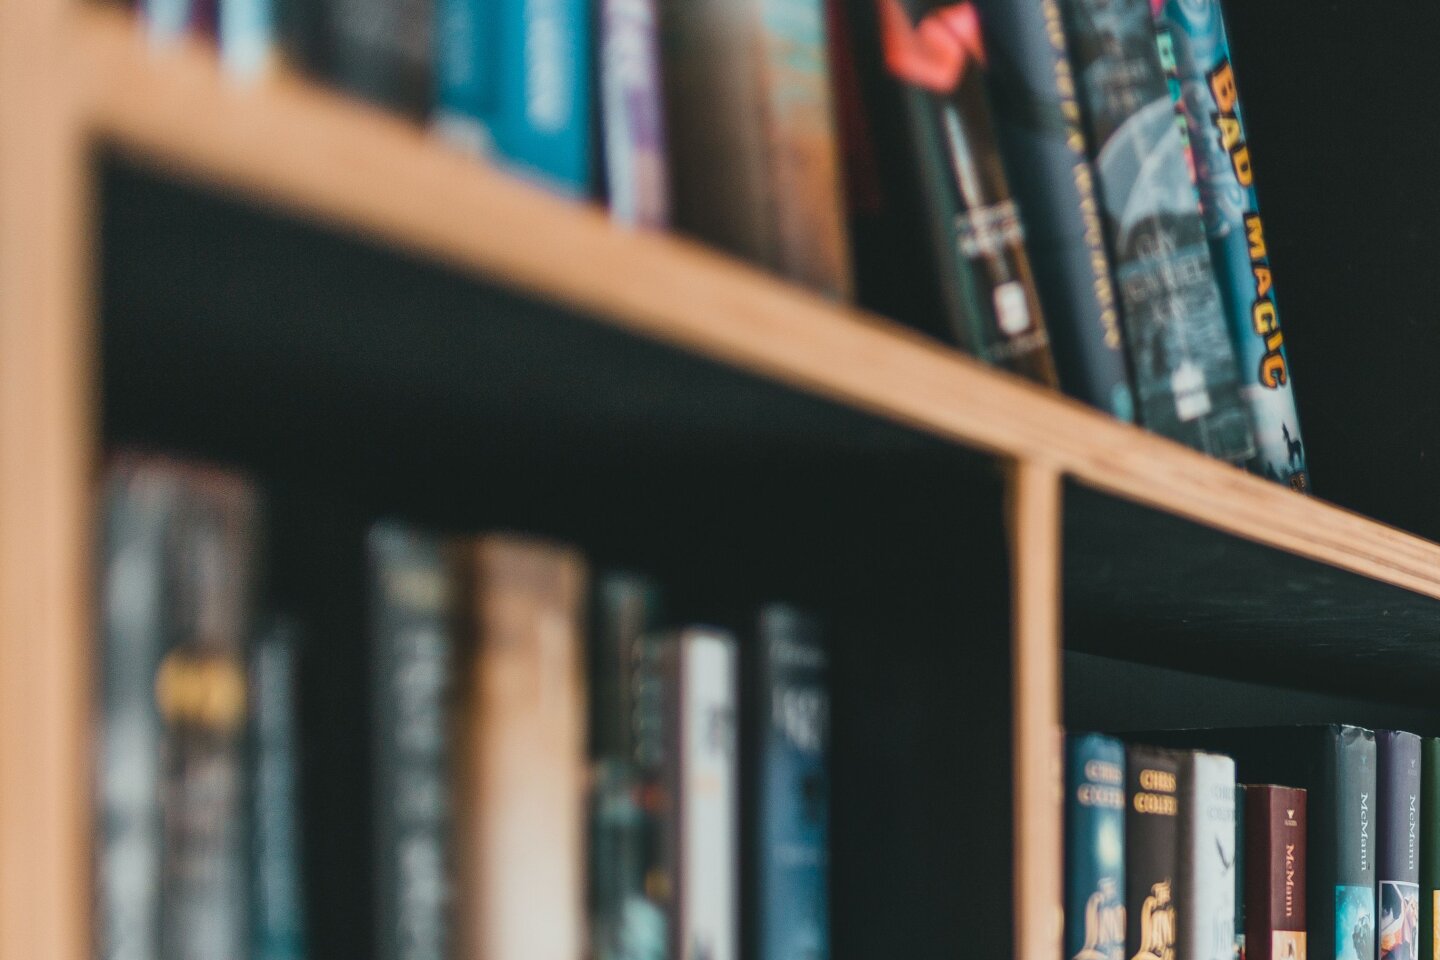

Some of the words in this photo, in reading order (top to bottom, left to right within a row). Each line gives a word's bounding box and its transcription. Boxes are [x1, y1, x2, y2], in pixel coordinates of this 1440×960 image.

[1206, 60, 1254, 187] BAD
[1244, 213, 1287, 389] MAGIC
[1361, 792, 1369, 871] McMann
[1286, 844, 1295, 917] McMann
